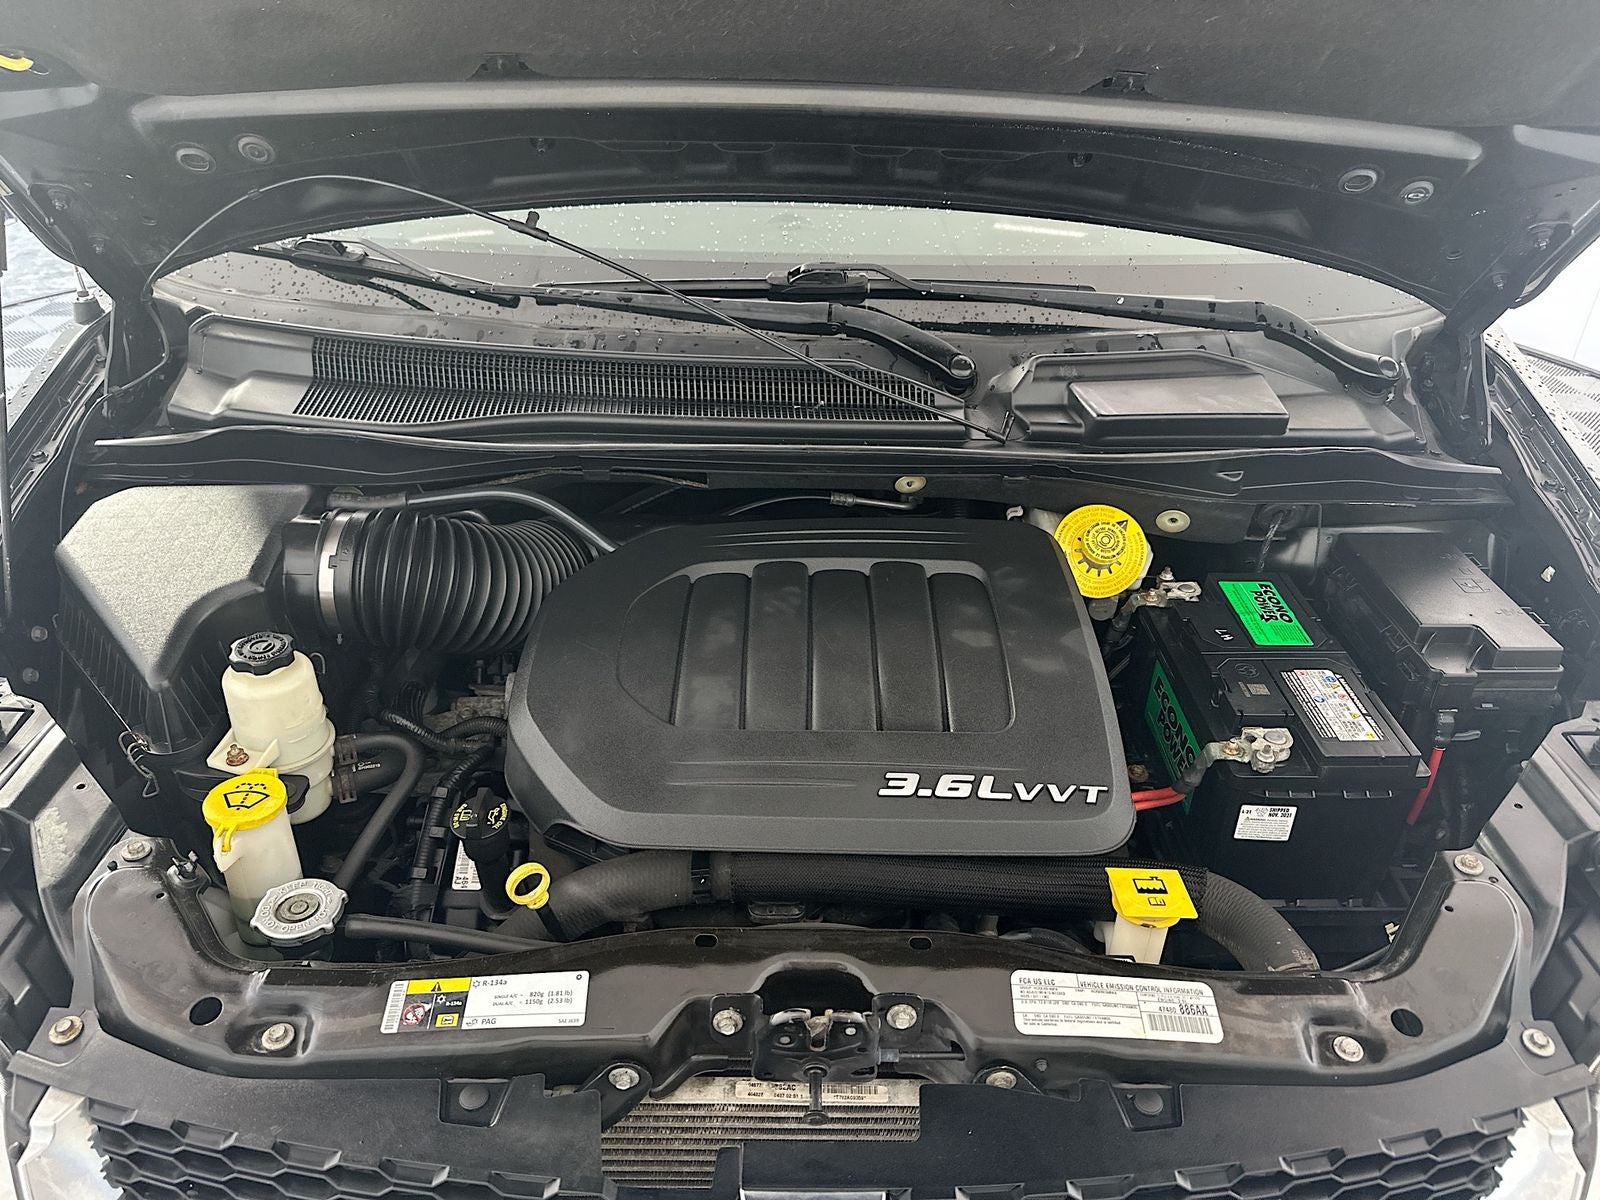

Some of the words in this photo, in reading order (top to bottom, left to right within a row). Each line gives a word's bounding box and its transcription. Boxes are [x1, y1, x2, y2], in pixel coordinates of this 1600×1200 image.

[1250, 588, 1279, 622] POWER
[1258, 584, 1293, 623] ECONO
[1154, 676, 1196, 768] ECONO
[1157, 706, 1187, 776] POWE
[878, 772, 1012, 800] 3.6L
[1014, 782, 1108, 804] VVT
[280, 922, 312, 932] OPEN
[1080, 981, 1104, 989] VEHICLE
[1106, 983, 1134, 991] EMISSION
[1163, 987, 1204, 996] INFORMATION
[1179, 1003, 1208, 1016] 886AA
